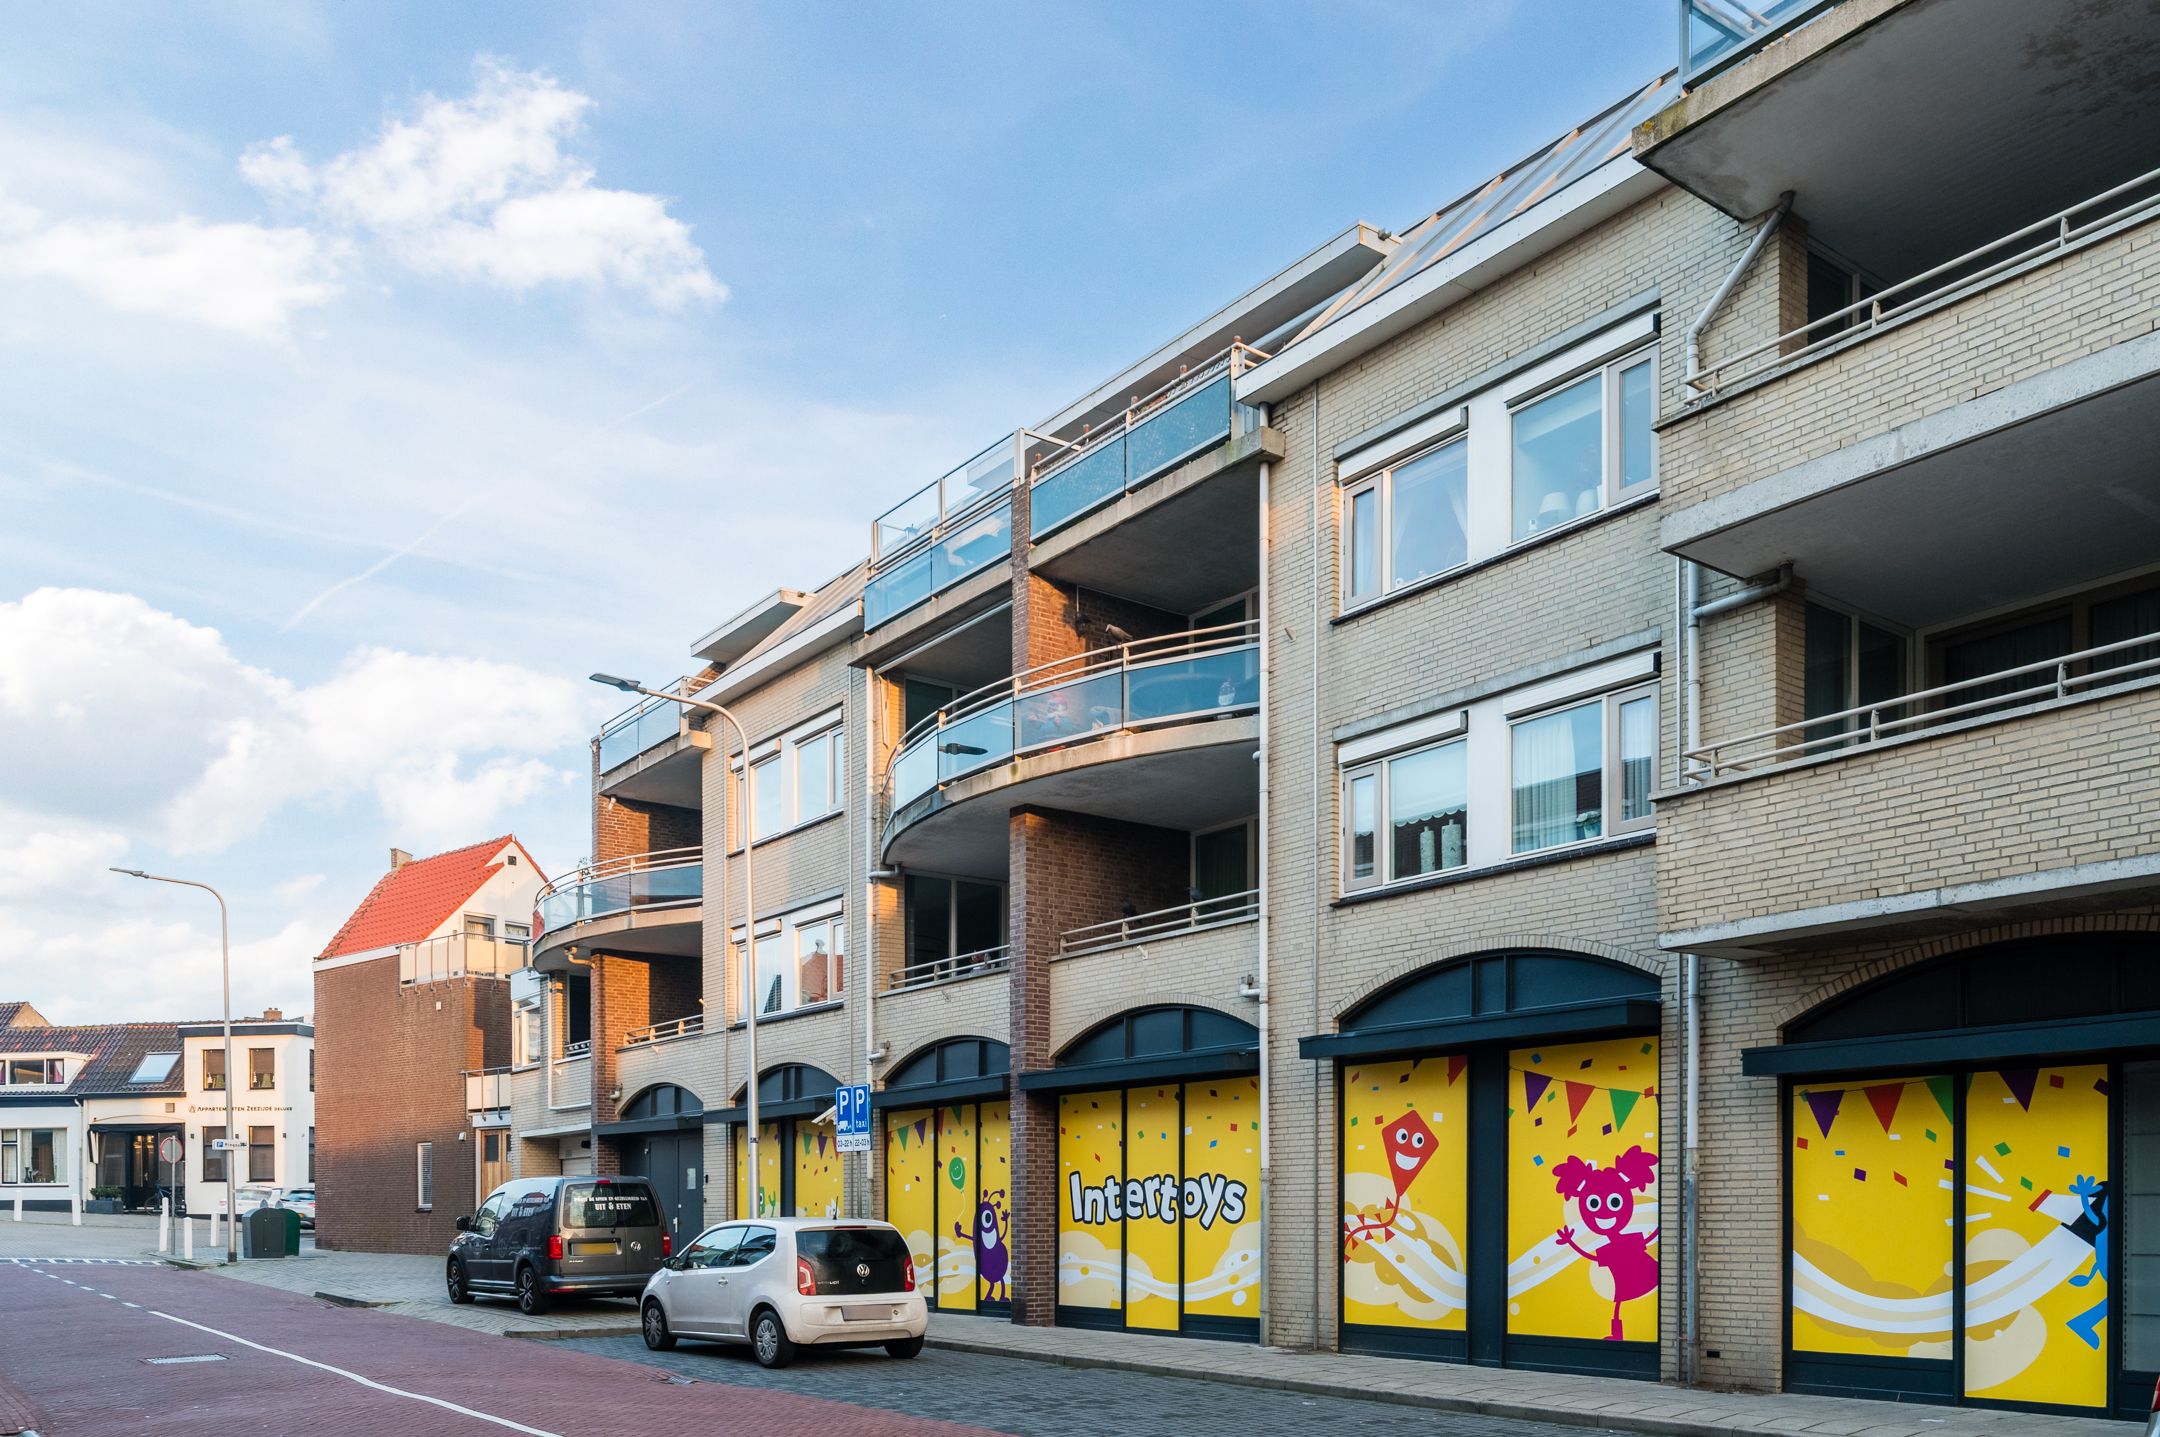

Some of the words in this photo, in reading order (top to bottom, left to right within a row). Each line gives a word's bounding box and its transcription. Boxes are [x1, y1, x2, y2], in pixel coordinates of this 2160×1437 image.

[840, 1091, 849, 1115] P
[856, 1089, 865, 1113] P
[856, 1119, 868, 1128] taxi
[594, 1203, 606, 1211] UIT
[608, 1202, 614, 1210] &
[1069, 1171, 1247, 1230] Intertoys
